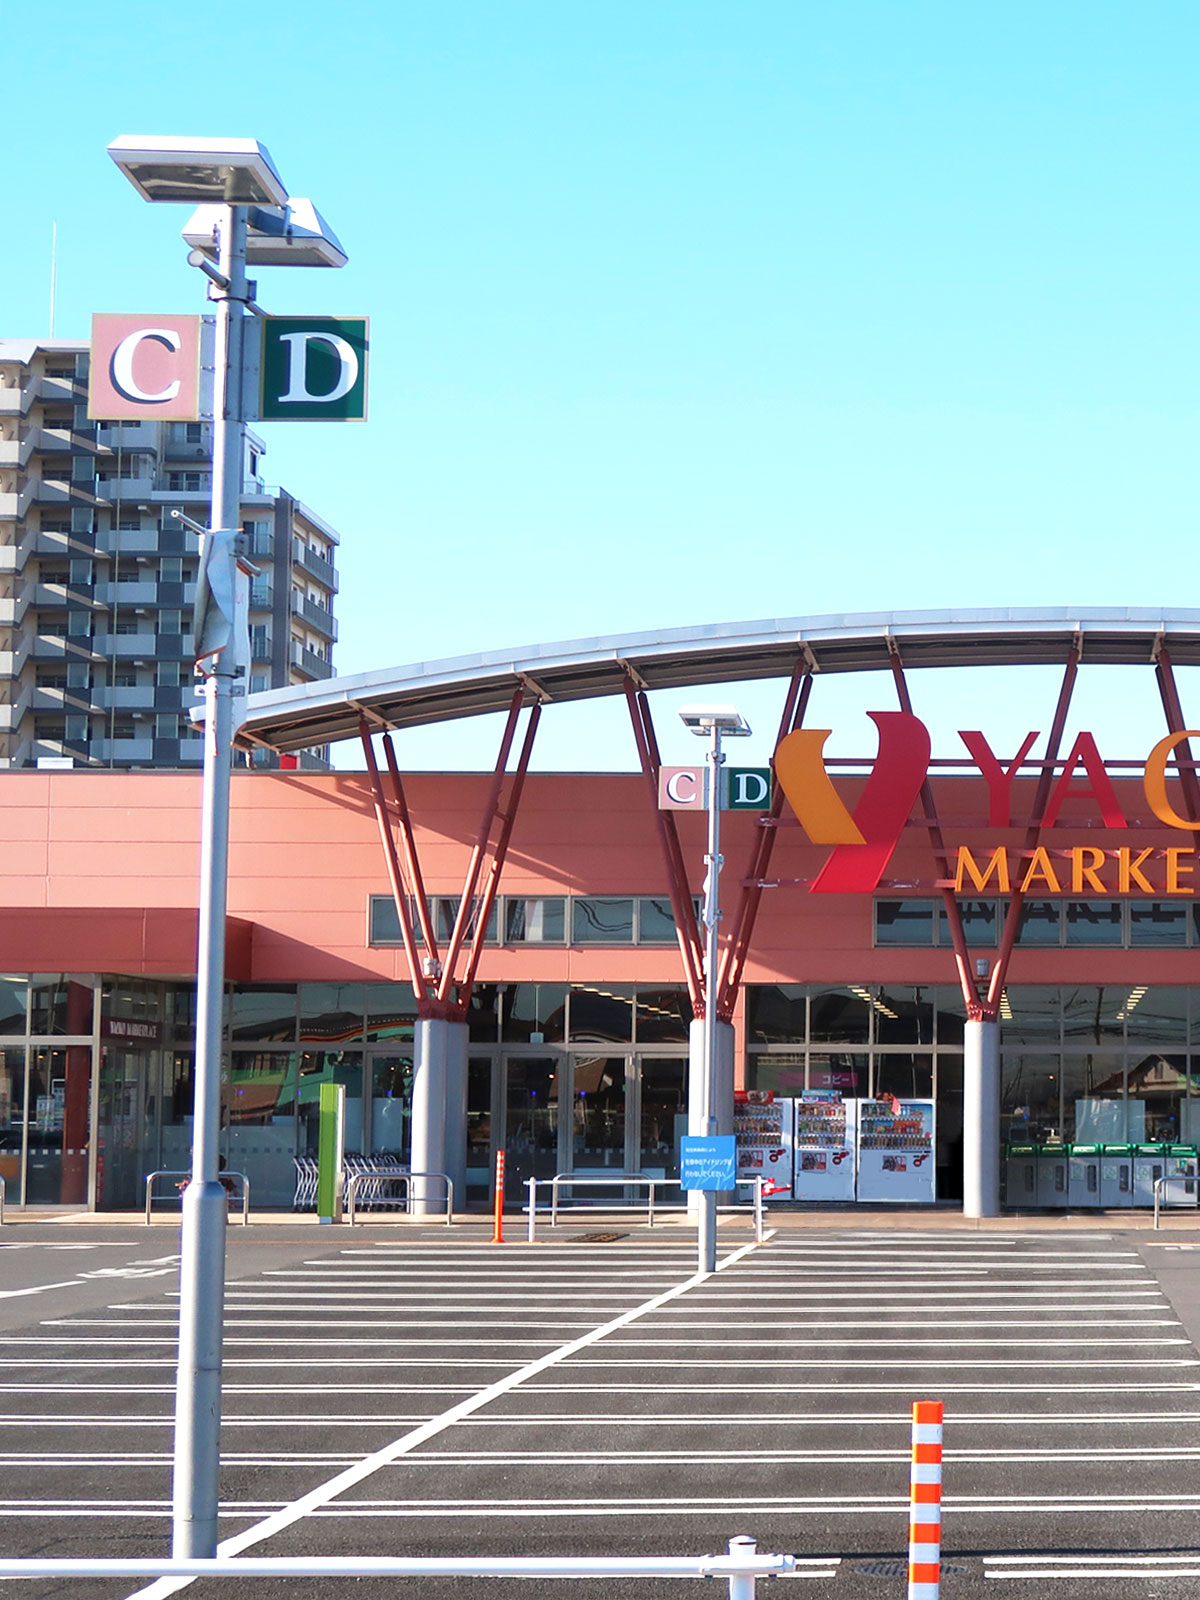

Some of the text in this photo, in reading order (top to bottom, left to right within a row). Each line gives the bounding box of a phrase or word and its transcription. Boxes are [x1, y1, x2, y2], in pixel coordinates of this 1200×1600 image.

[109, 328, 181, 405] C
[278, 331, 359, 403] D
[667, 771, 697, 804] C
[734, 773, 768, 804] D
[822, 1074, 850, 1086] コピー
